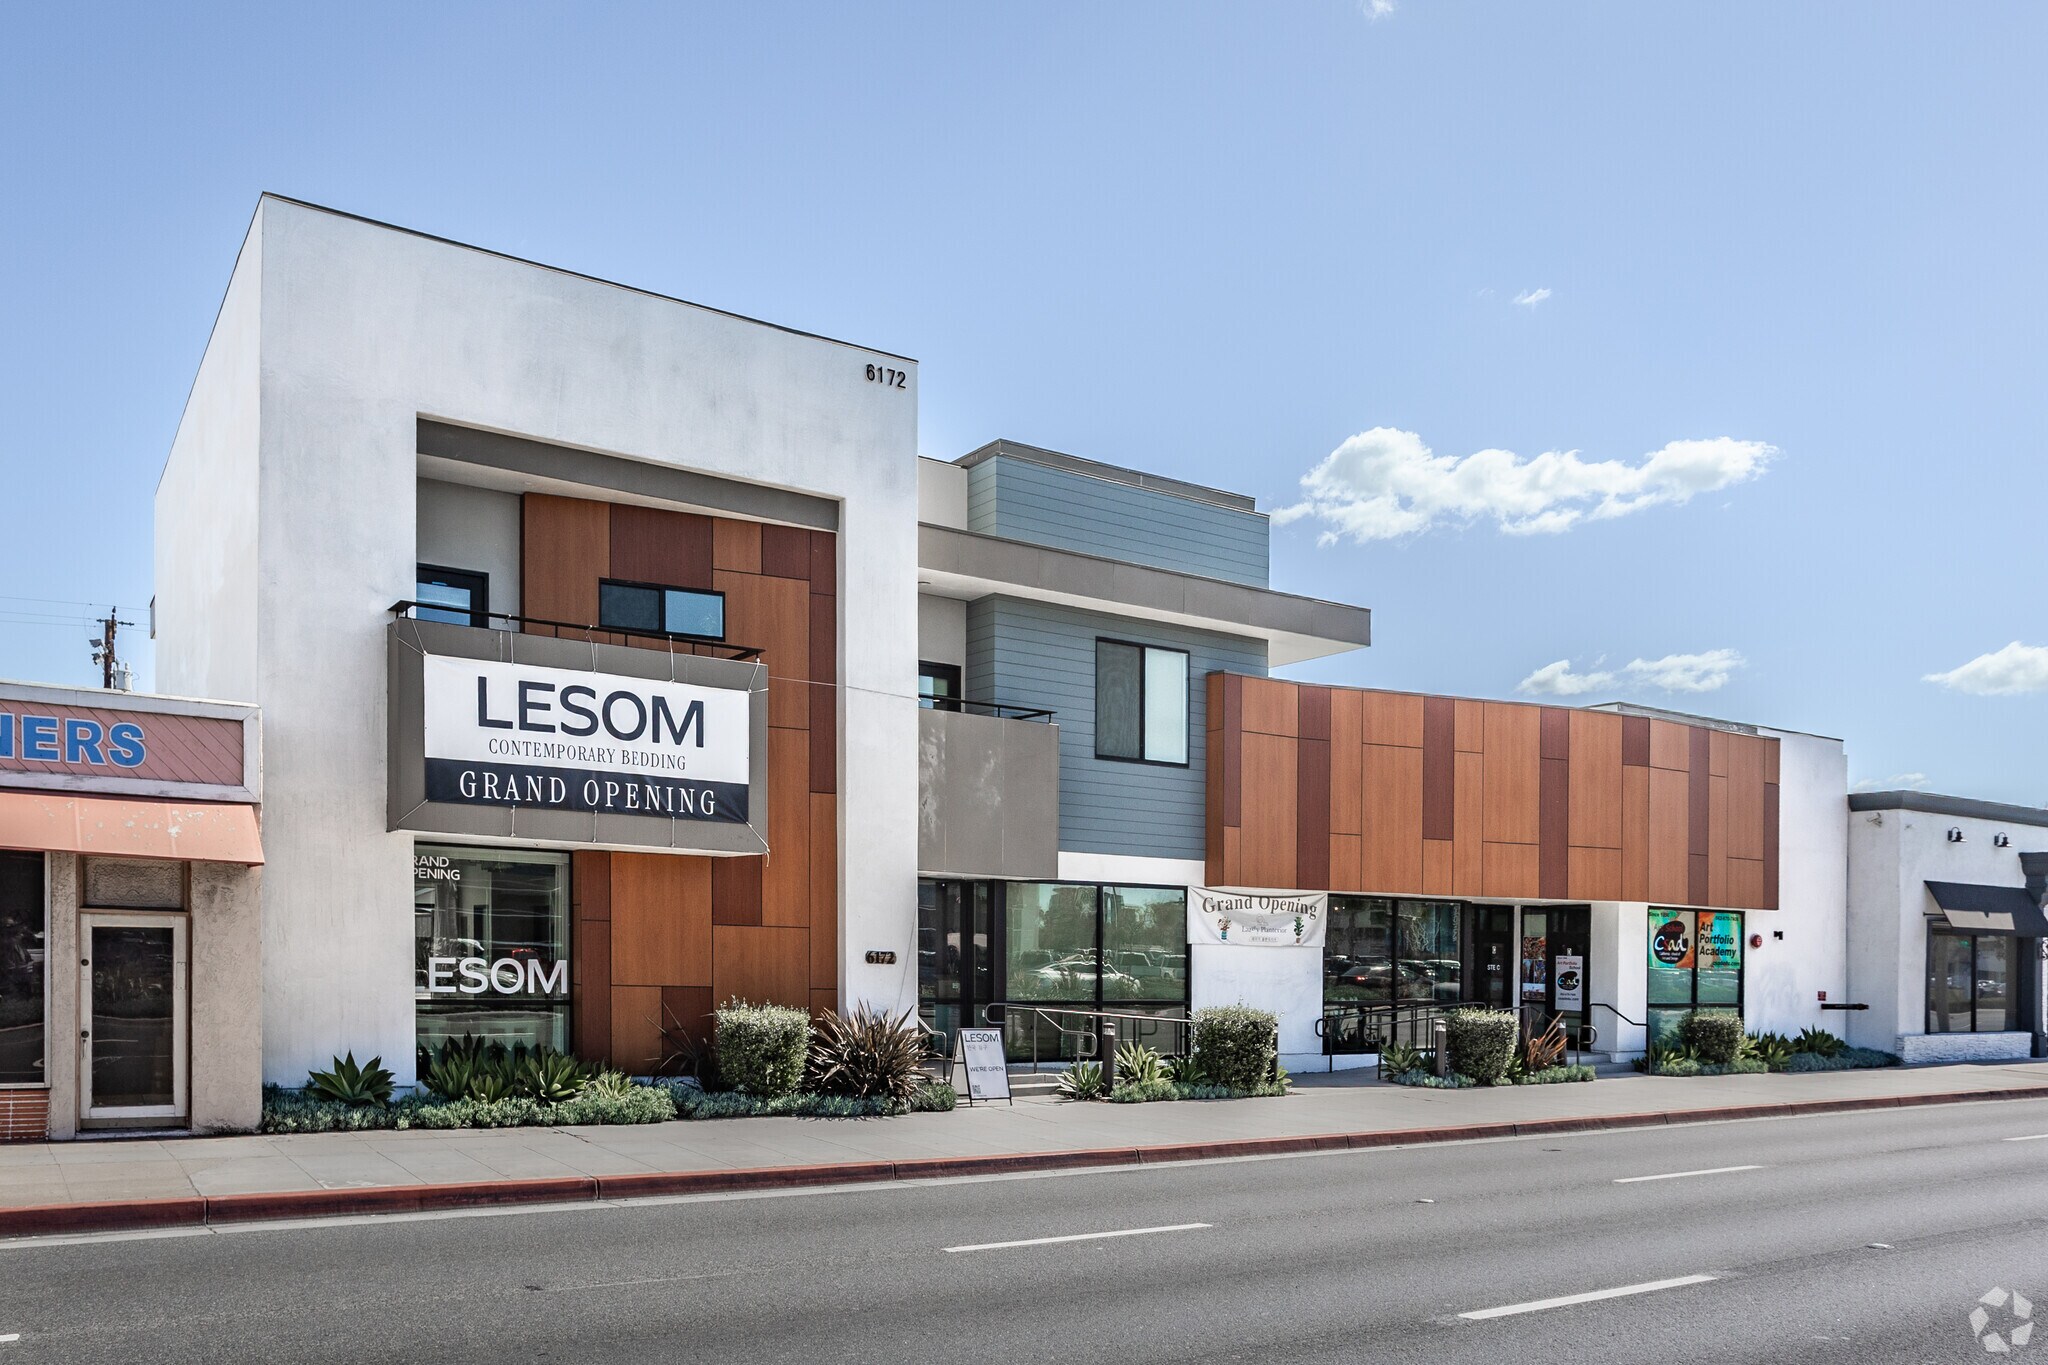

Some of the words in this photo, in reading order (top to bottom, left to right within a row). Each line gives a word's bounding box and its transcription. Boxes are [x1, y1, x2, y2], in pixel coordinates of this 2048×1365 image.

[866, 364, 906, 389] 6172
[477, 676, 704, 748] LESOM
[488, 738, 615, 764] CONTEMPORARY
[621, 750, 686, 771] BEDDING
[459, 770, 566, 803] GRAND
[583, 779, 716, 816] OPENING
[1202, 896, 1252, 913] Grand
[1258, 896, 1317, 920] Opening
[1700, 921, 1713, 932] Art
[1699, 933, 1735, 945] Portfolio
[866, 951, 895, 964] 6172
[1699, 946, 1737, 958] Academy
[415, 957, 568, 994] ESOM
[964, 1033, 999, 1043] LESOM
